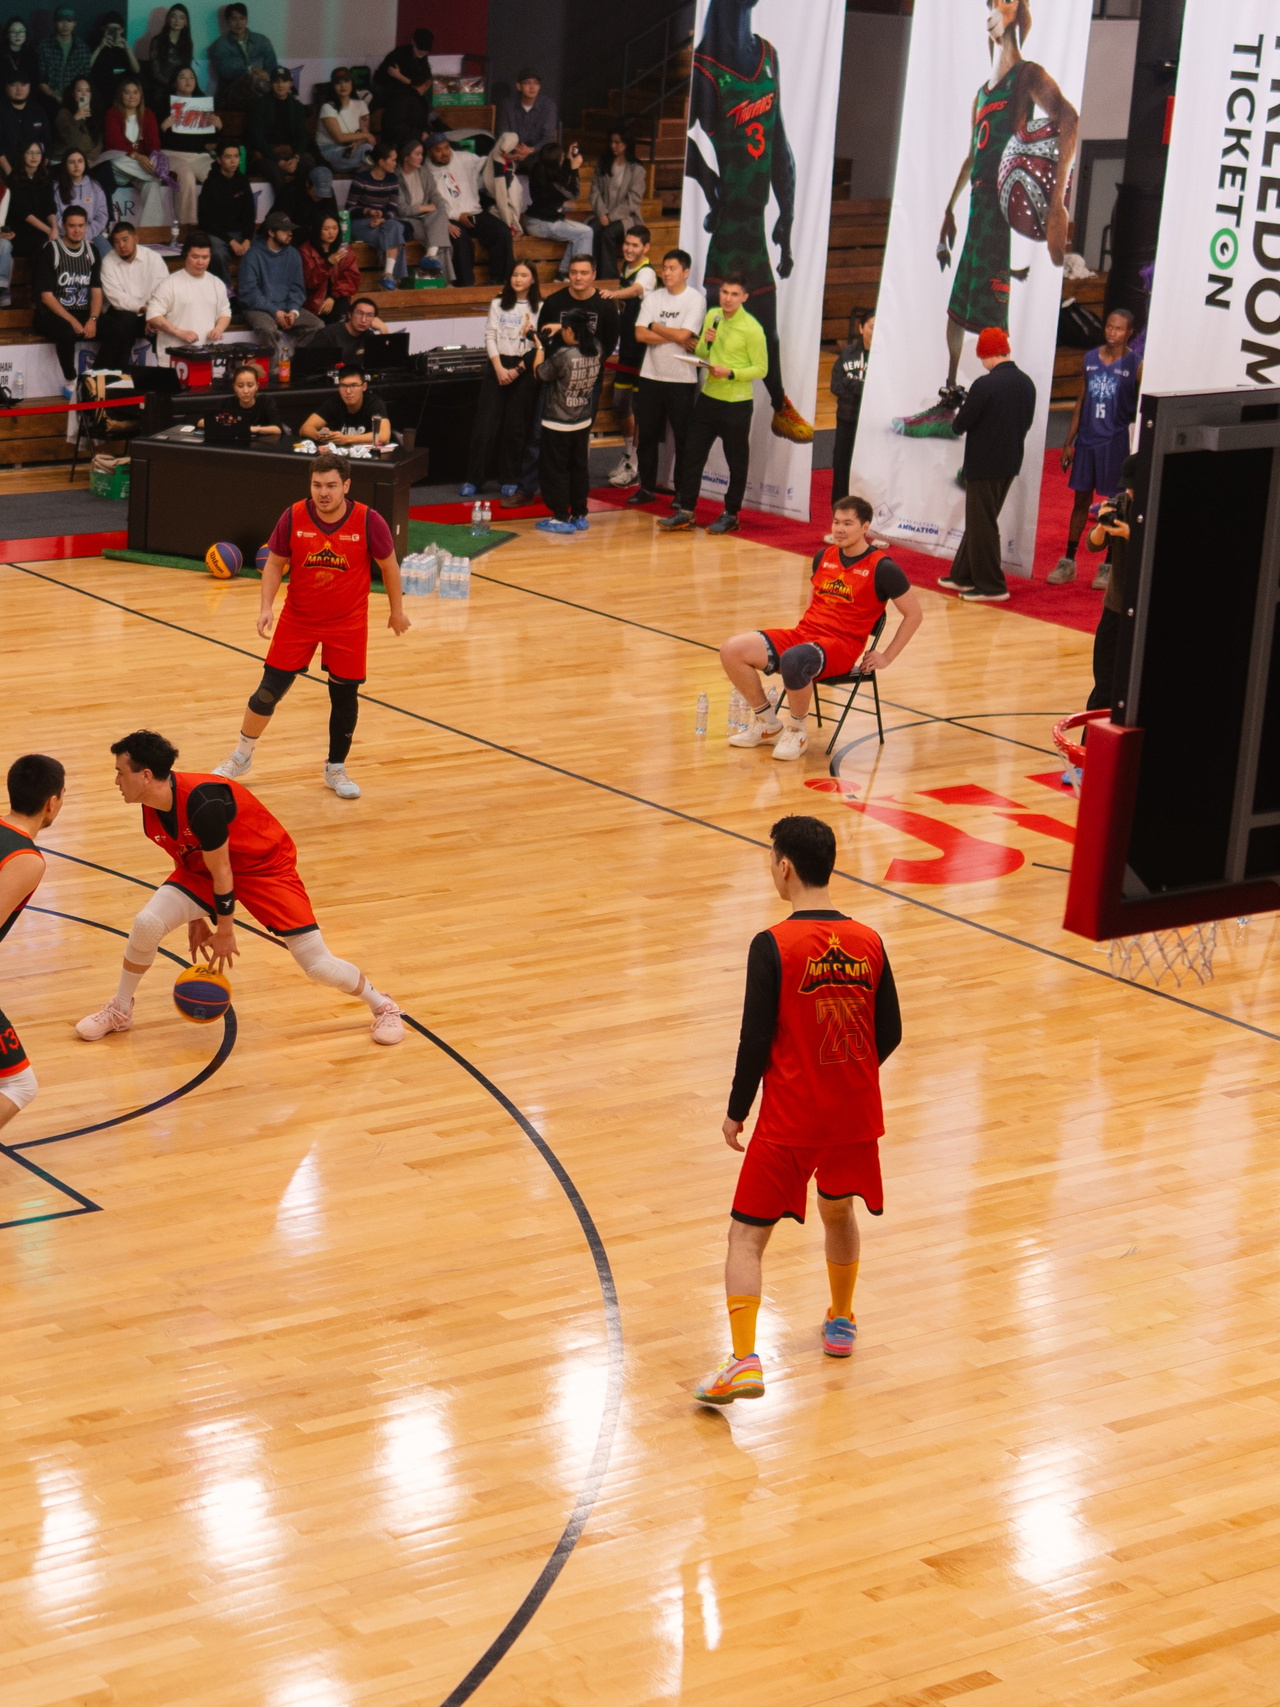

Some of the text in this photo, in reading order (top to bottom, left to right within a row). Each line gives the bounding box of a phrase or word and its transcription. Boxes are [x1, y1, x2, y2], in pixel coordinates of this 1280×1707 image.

[745, 122, 766, 160] 3
[1204, 34, 1265, 311] TICKETON
[60, 287, 89, 307] 32
[570, 369, 587, 381] BIG
[1095, 402, 1106, 419] 15
[897, 523, 939, 535] ANIMATION
[305, 555, 348, 571] MAGMA
[820, 582, 852, 601] MAGMA
[803, 961, 873, 988] MAGMA
